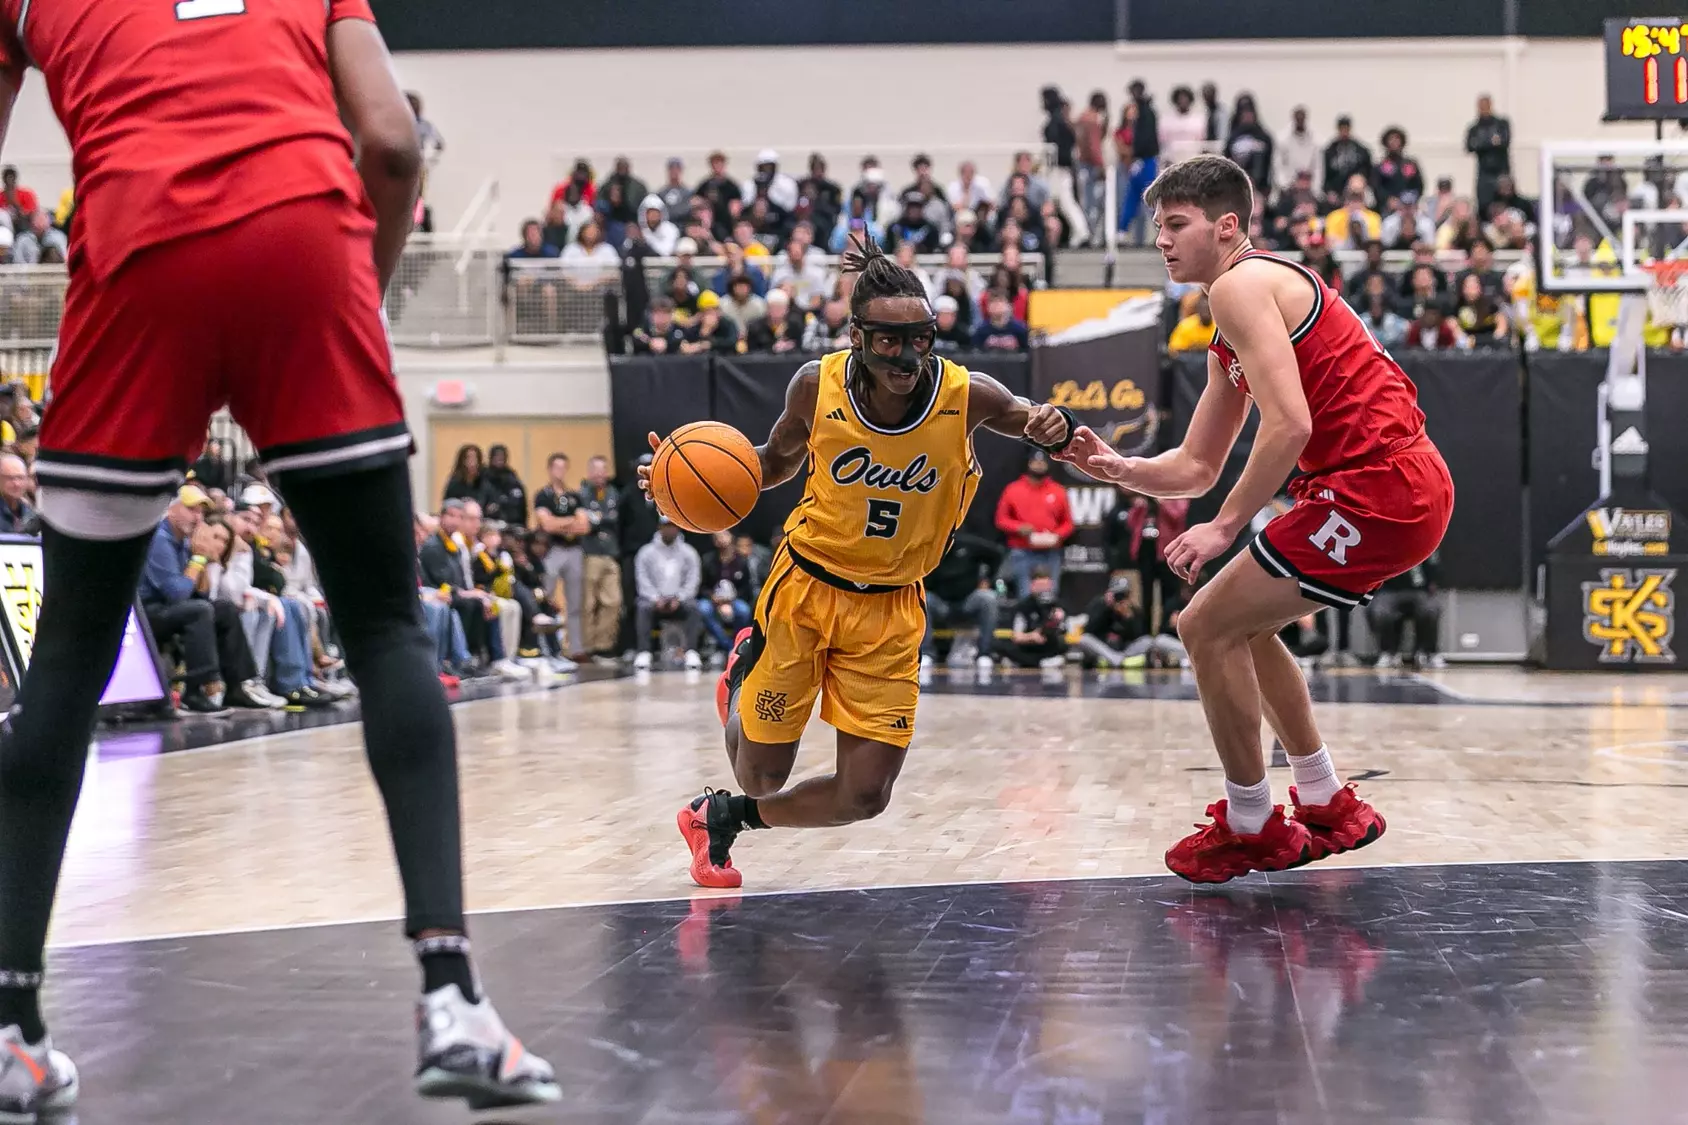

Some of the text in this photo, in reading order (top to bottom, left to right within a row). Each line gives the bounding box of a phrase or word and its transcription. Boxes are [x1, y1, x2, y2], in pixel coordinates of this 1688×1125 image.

[829, 446, 941, 494] Owls
[864, 498, 902, 540] 5
[1308, 509, 1363, 566] R
